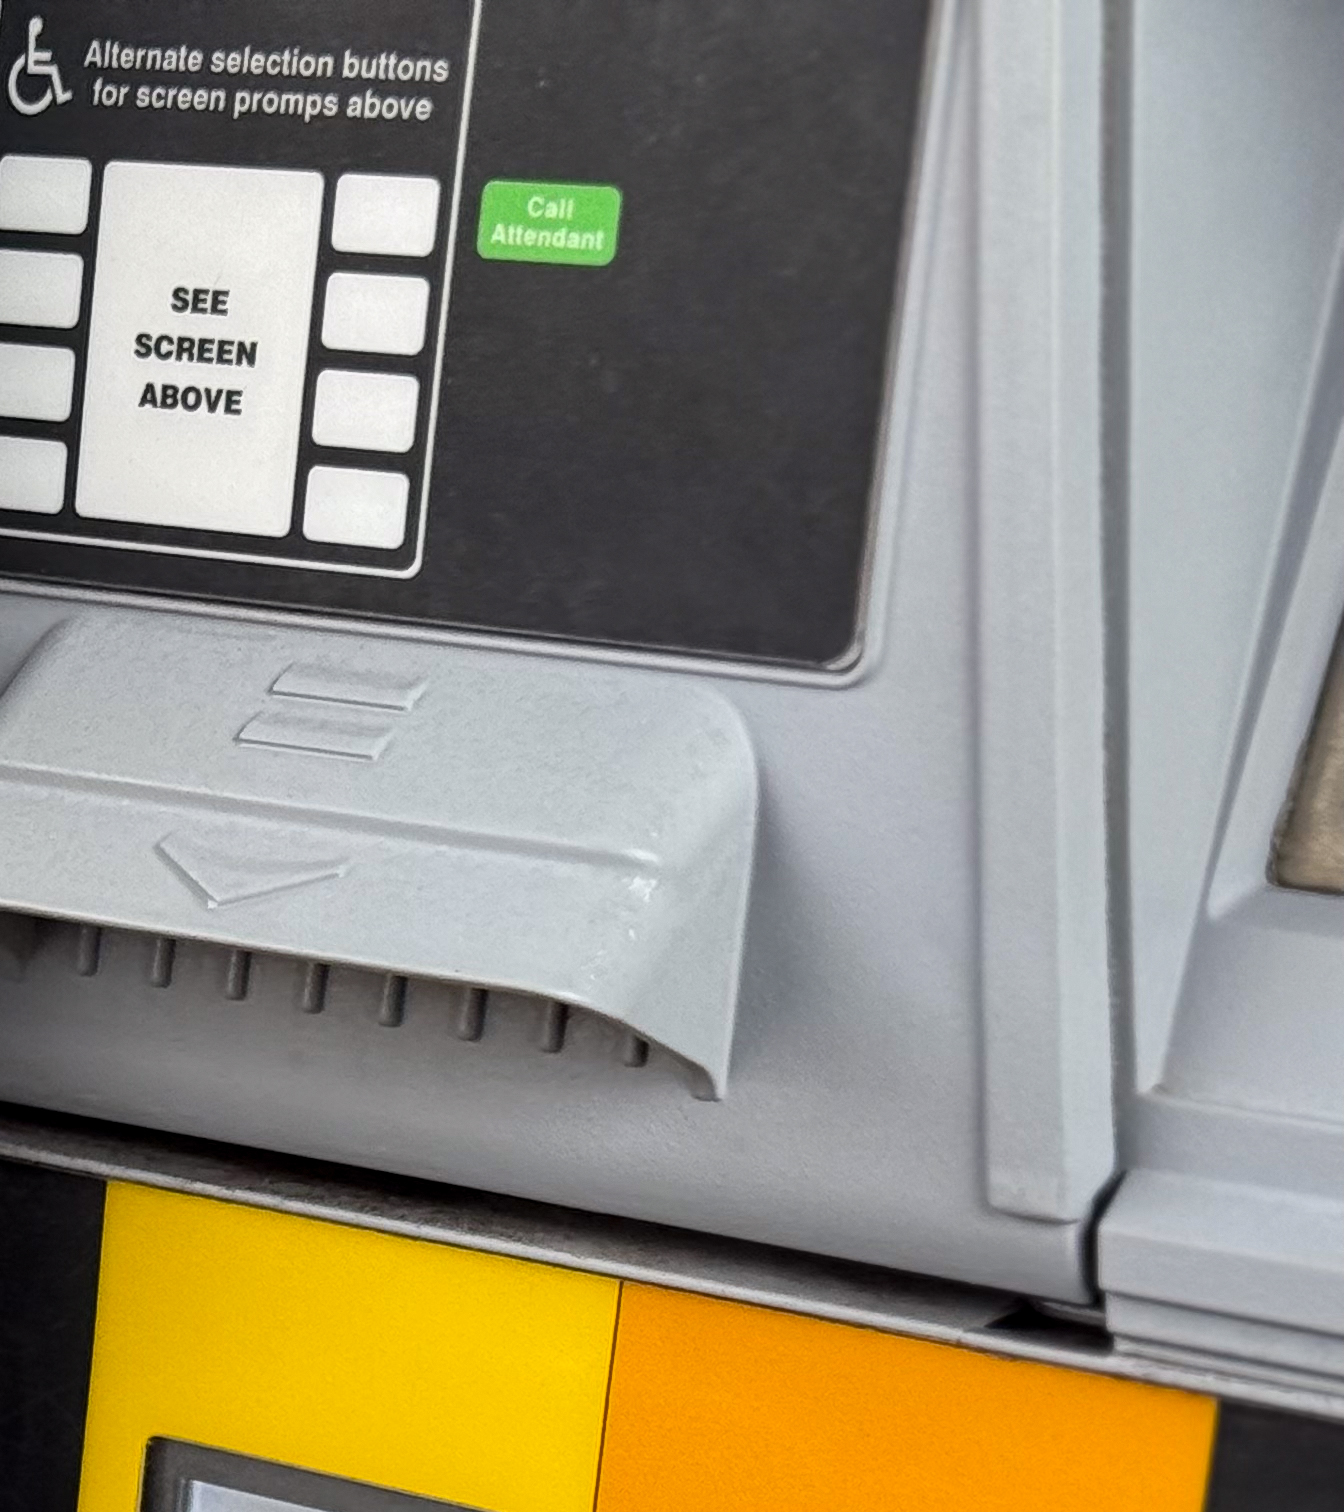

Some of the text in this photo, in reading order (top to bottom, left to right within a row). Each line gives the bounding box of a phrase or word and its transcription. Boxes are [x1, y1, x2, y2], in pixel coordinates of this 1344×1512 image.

[83, 38, 450, 84] Alternate selection buttons
[92, 80, 433, 122] for screen promps above
[489, 196, 605, 253] Call Attendant
[170, 286, 230, 316] SEE
[133, 333, 257, 367] SCREEN
[137, 382, 244, 415] ABOVE
